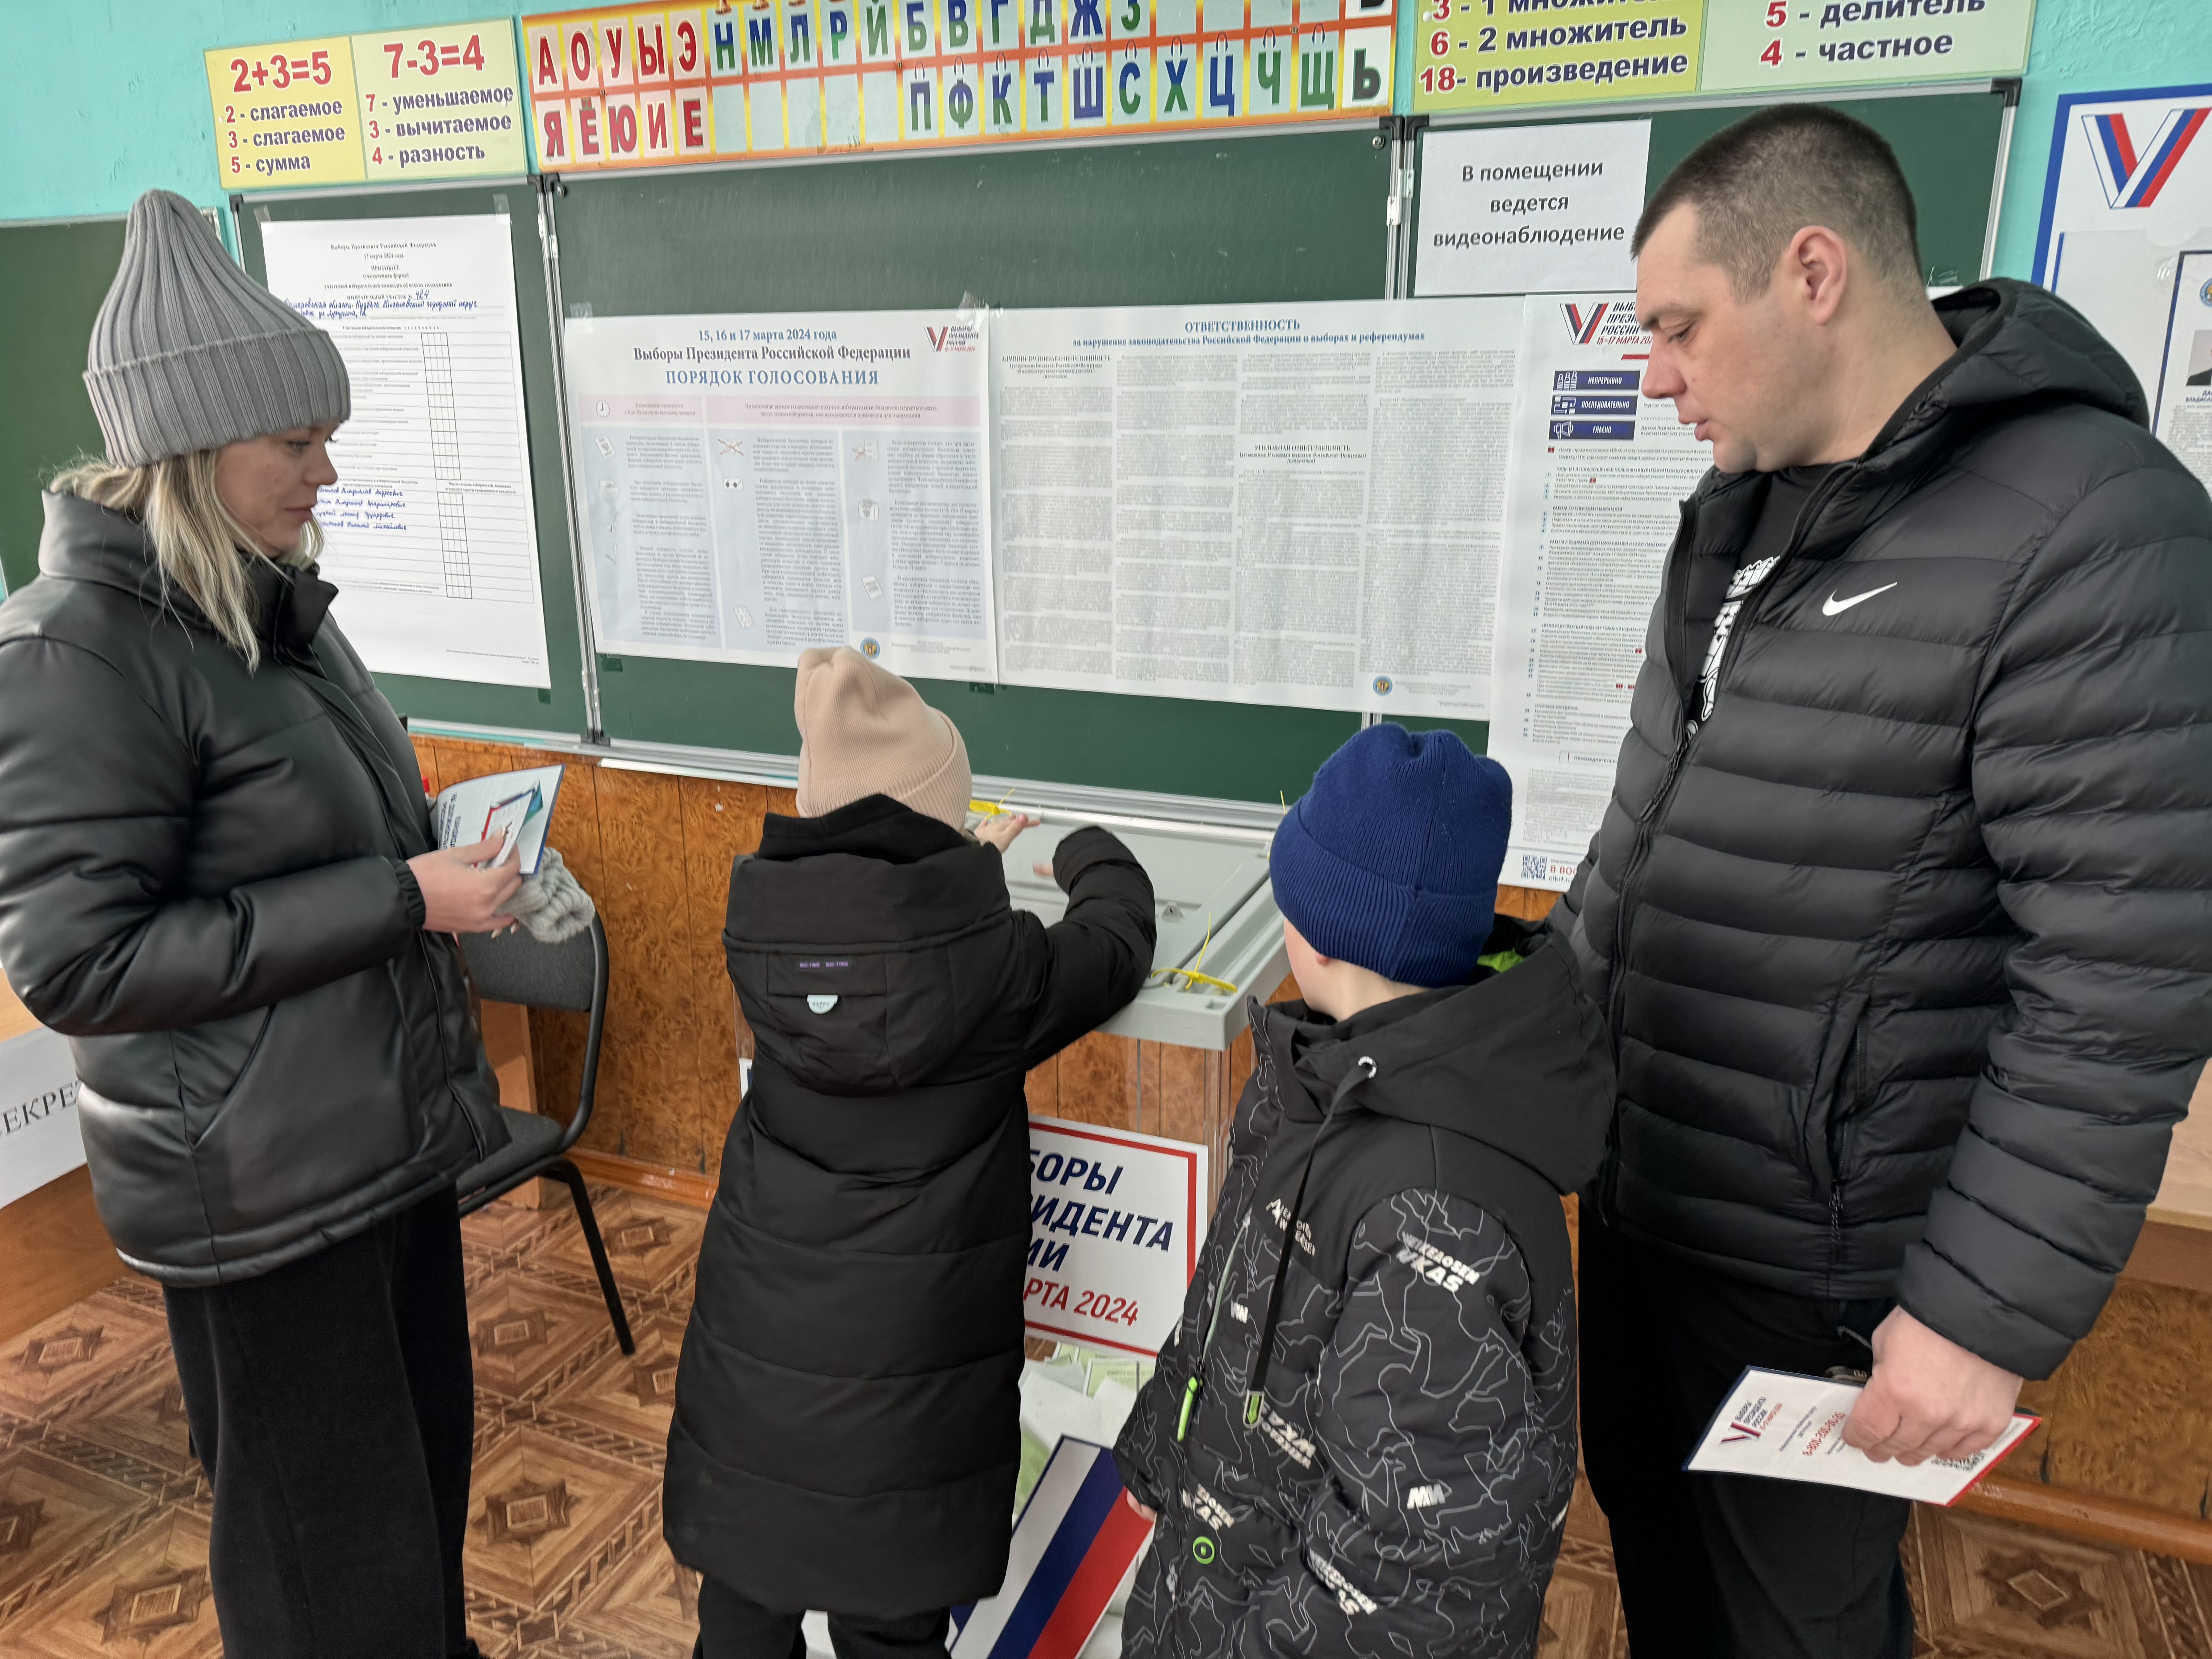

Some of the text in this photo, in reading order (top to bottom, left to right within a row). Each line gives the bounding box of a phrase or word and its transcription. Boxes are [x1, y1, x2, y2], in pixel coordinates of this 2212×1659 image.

[1766, 1, 1786, 27] 5
[1431, 31, 1449, 56] 6
[1478, 26, 1496, 53] 2
[1506, 16, 1687, 51] множитель
[384, 34, 484, 78] 7-3=4
[1760, 39, 1782, 66] 4
[1819, 34, 1953, 62] частное
[231, 50, 331, 93] 2+3=5
[1476, 54, 1688, 94] произведение
[226, 106, 235, 124] 2
[250, 100, 342, 122] слагаемое
[366, 93, 375, 112] 7
[393, 86, 513, 115] уменьшаемое
[229, 131, 237, 149] 3
[253, 125, 345, 147] слагаемое
[369, 120, 380, 139] 3
[397, 114, 512, 137] вычитаемое
[232, 156, 240, 173] 5
[256, 155, 310, 176] сумма
[372, 147, 382, 165] 4
[400, 145, 485, 168] разность
[1463, 162, 1603, 182] В помещении
[1491, 196, 1568, 215] ведется
[1434, 225, 1624, 250] видеонаблюдение
[1613, 302, 1636, 312] ВЫБ
[699, 328, 837, 343] 15, 16 и 17 марта 2024 года
[1185, 319, 1300, 333] ОТВЕТСТВЕННОСТЬ
[1601, 325, 1640, 335] РОССИИ
[1083, 338, 1127, 348] нарушение
[1128, 337, 1200, 348] законодательства
[1202, 334, 1251, 345] Российской
[1253, 333, 1301, 346] Федерации
[1311, 332, 1348, 344] выборах
[1351, 334, 1357, 342] и
[1359, 331, 1425, 344] референдумах
[1616, 336, 1640, 345] МАРТА
[634, 345, 910, 363] Выборы Президента Российской Федерации
[666, 370, 878, 387] ПОРЯДОК ГОЛОСОВАНИЯ
[1588, 376, 1622, 385] НЕПРЕРЫВНО
[1581, 401, 1630, 409] ПОСЛЕДОВАТЕЛЬНО
[1593, 426, 1611, 434] ГЛАСНО
[0, 1080, 79, 1137] ЕКРЕ
[1032, 1194, 1173, 1252] ИДЕНТА
[1073, 1290, 1139, 1327] 2024
